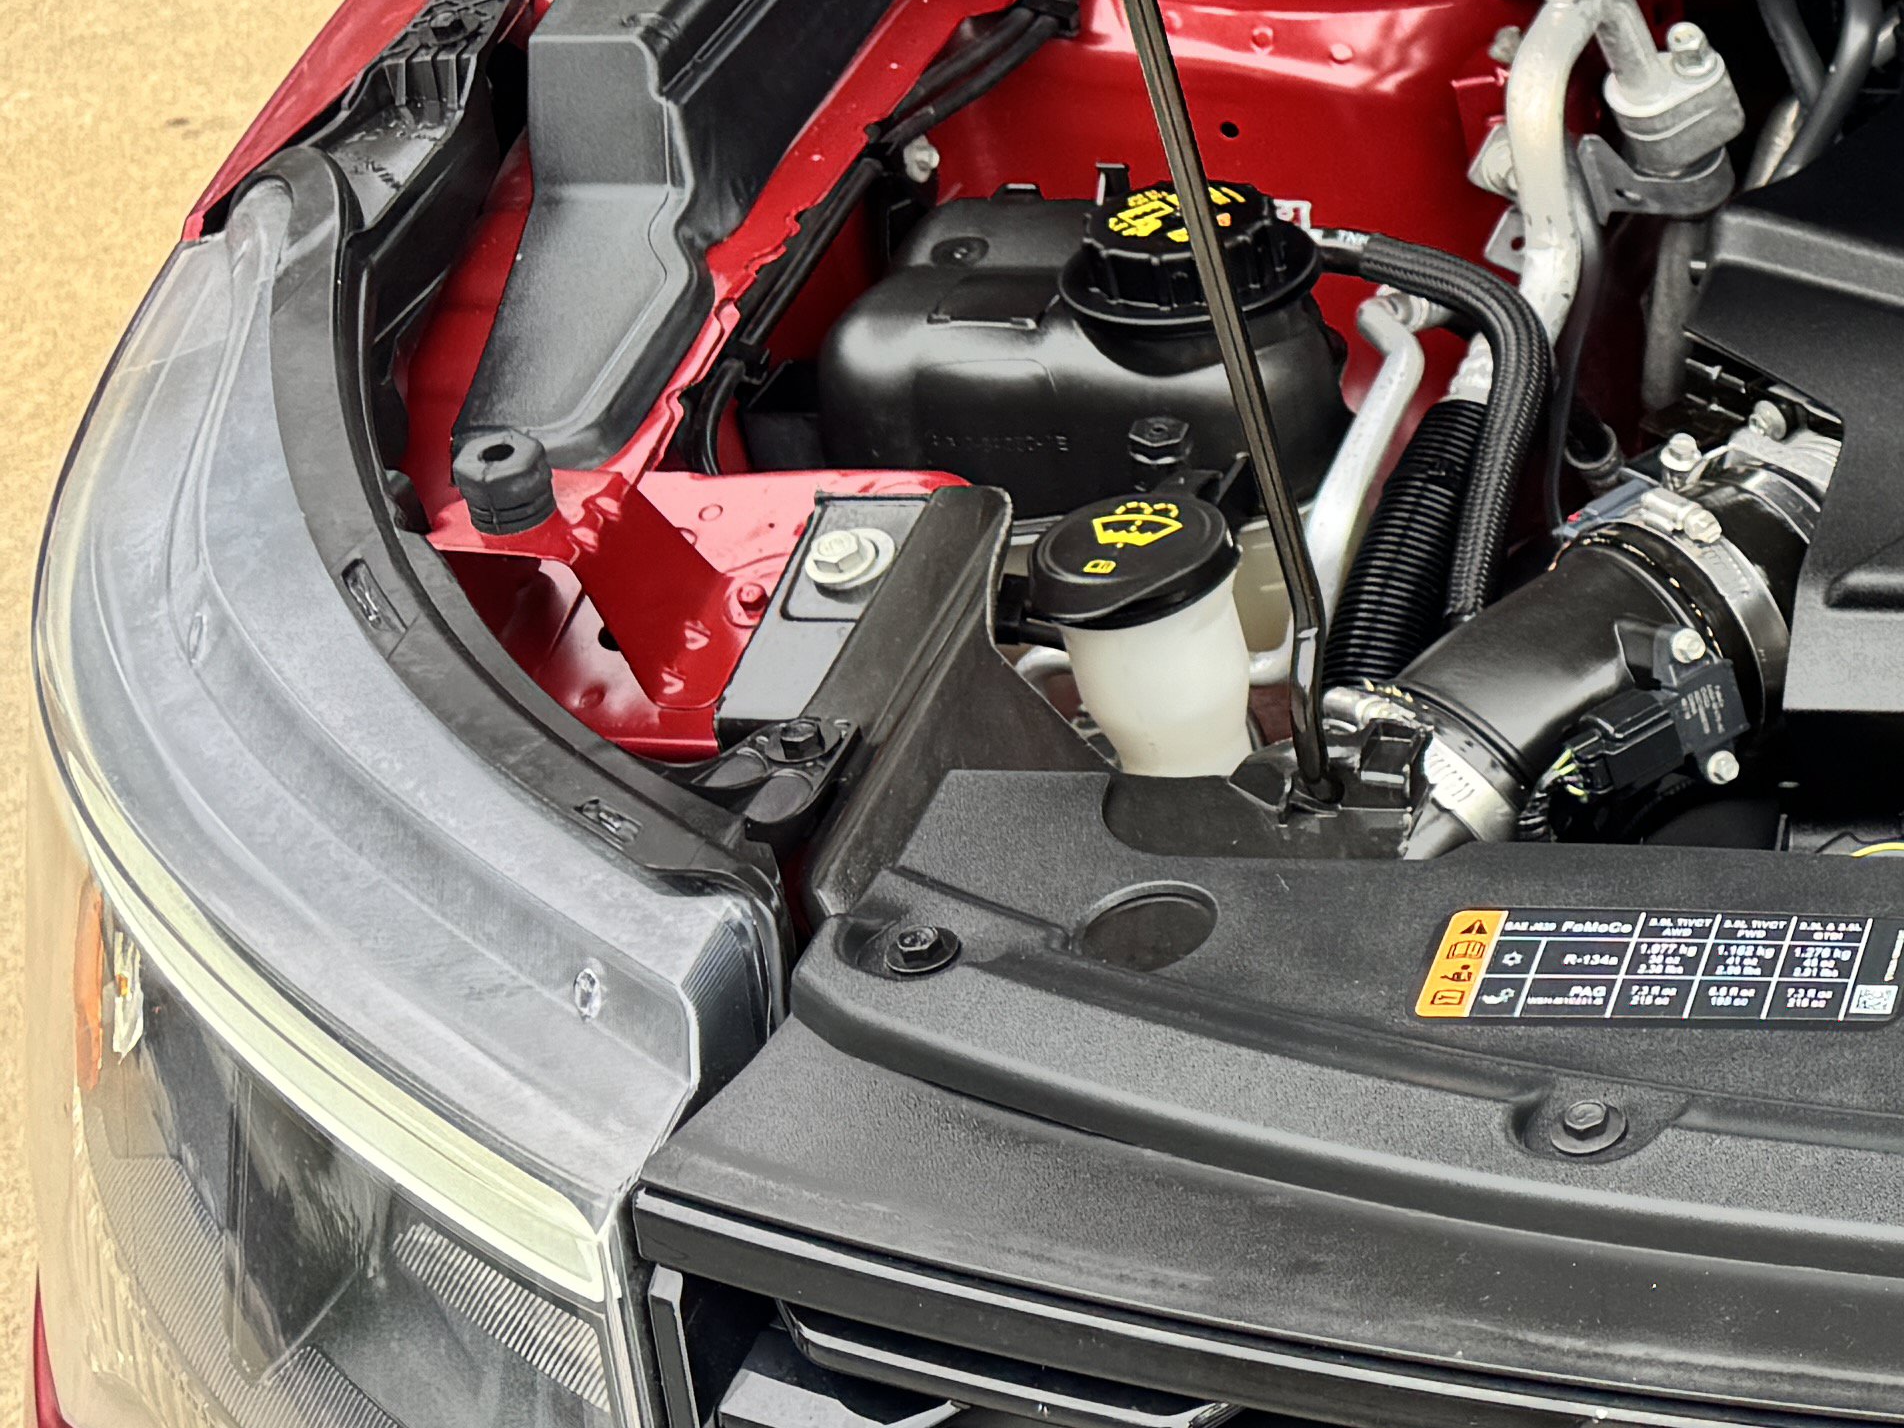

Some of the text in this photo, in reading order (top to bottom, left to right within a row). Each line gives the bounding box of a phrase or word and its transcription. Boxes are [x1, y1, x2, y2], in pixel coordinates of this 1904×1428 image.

[1561, 920, 1633, 933] FoMoCo
[1678, 944, 1698, 957] kg
[1756, 946, 1776, 959] kg
[1833, 947, 1852, 961] kg
[1563, 953, 1619, 966] R-134a
[1569, 985, 1607, 997] PAG
